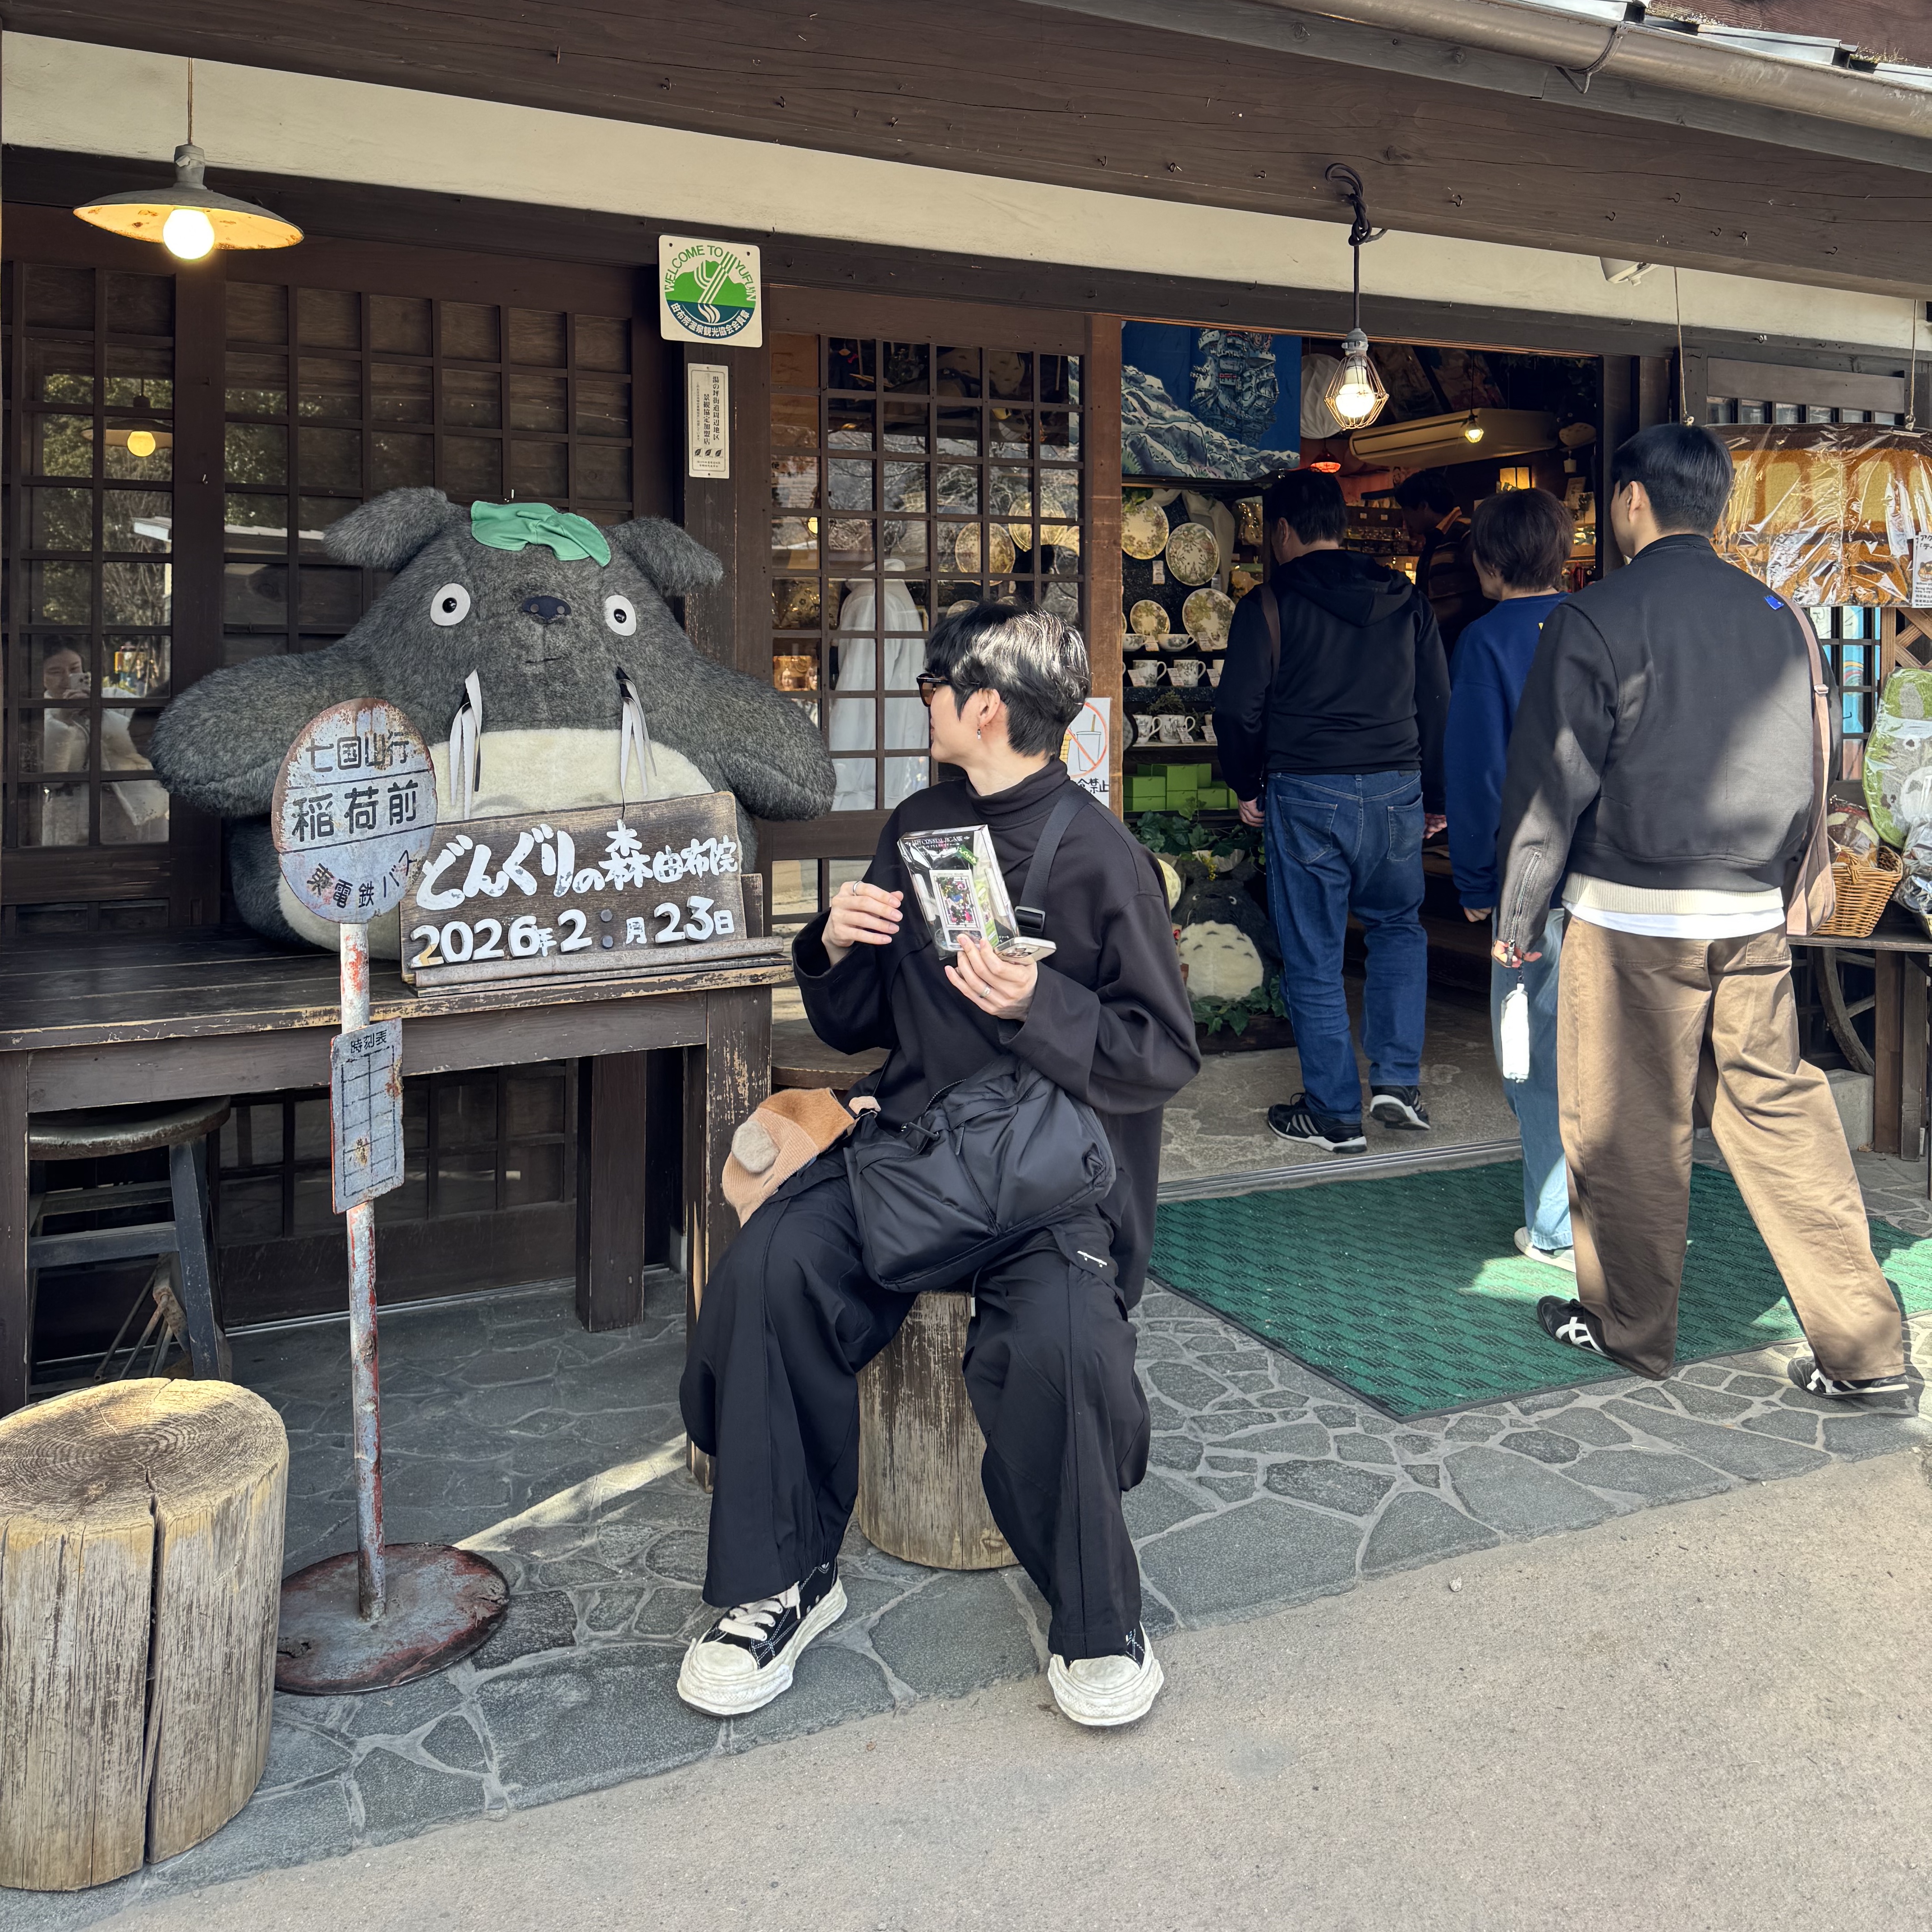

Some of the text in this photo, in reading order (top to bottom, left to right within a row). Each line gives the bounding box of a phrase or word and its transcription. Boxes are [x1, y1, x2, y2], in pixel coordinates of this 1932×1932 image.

[664, 245, 756, 301] WELCOME TO YUFUIN
[305, 731, 410, 773] 七国山行
[291, 779, 419, 842] 稲荷前
[350, 1029, 387, 1054] 時刻表
